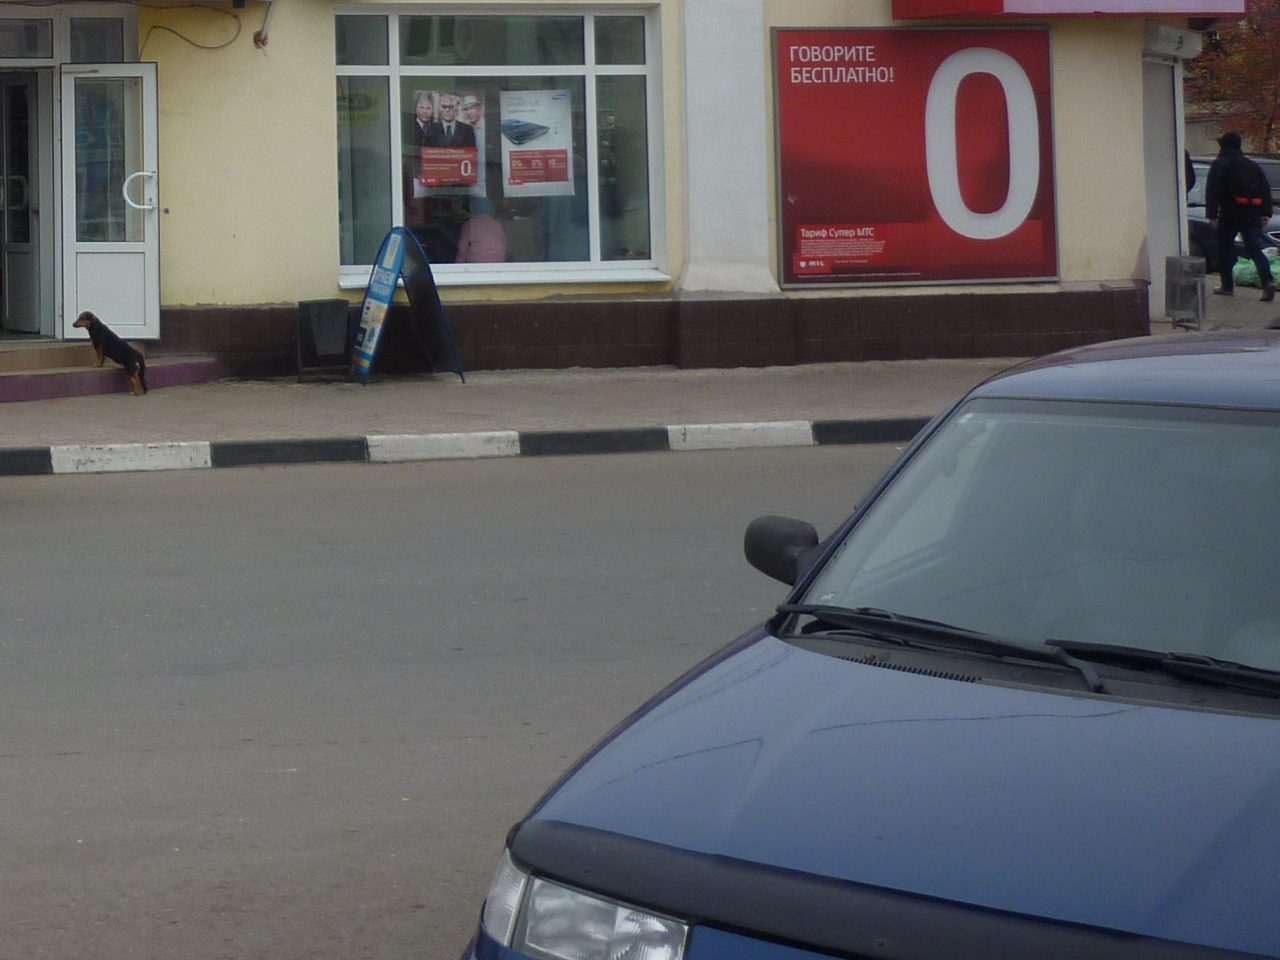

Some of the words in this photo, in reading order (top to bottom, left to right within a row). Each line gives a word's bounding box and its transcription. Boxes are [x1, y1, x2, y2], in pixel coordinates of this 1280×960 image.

[789, 46, 876, 62] ГОВОРИТЕ
[790, 66, 894, 83] БЕСПЛАТНО!
[924, 46, 1040, 240] 0
[801, 228, 828, 238] Тариф
[828, 228, 856, 238] Супер
[856, 227, 875, 236] МТС
